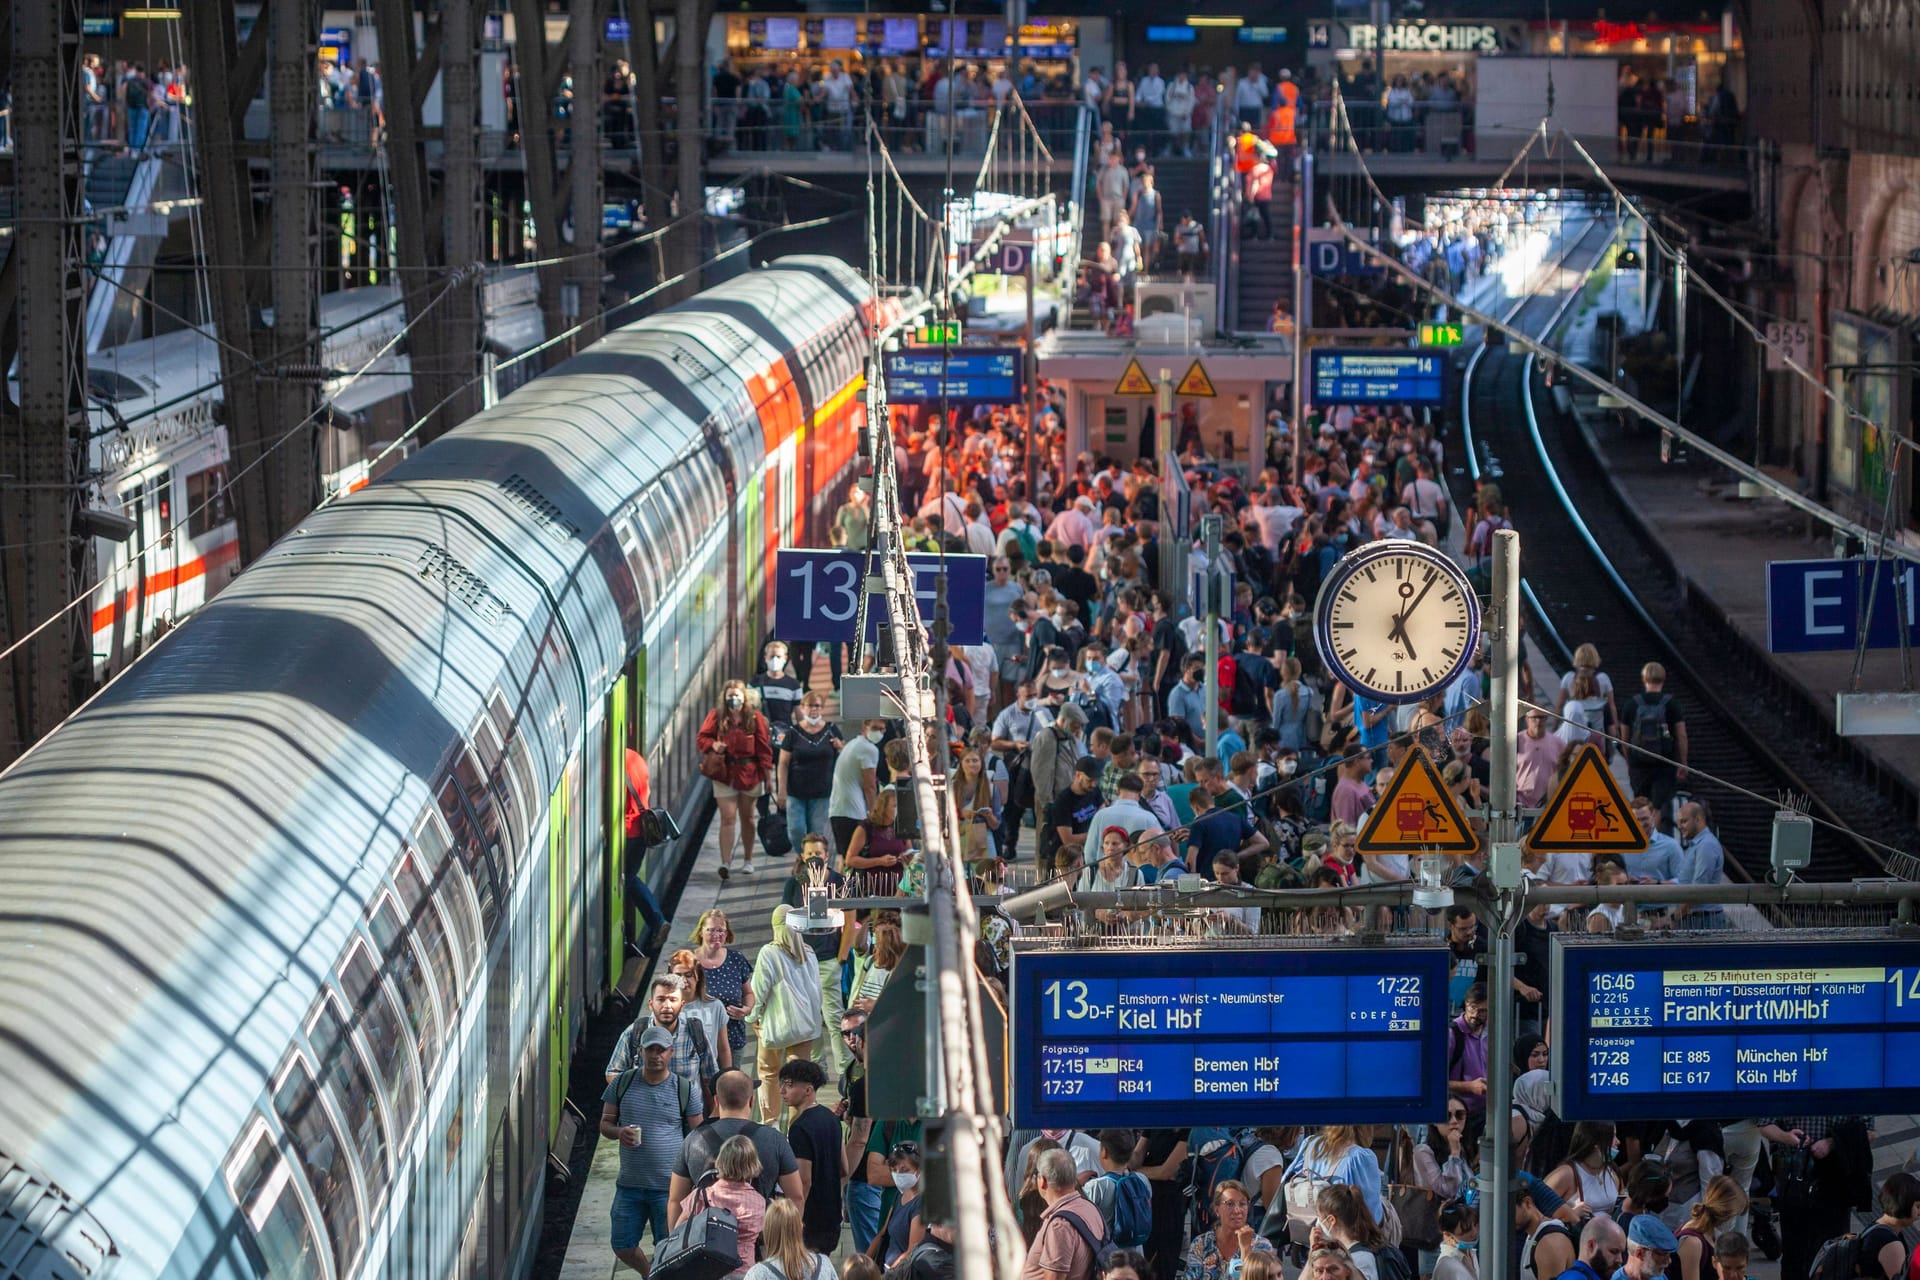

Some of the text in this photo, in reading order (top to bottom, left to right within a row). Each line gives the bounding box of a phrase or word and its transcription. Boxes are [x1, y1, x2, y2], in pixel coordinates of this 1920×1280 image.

[1003, 245, 1024, 272] D
[1319, 243, 1339, 271] D
[1417, 357, 1433, 373] 14
[790, 560, 858, 622] 13
[1804, 570, 1845, 635] E
[1377, 977, 1420, 994] 17:22
[1592, 973, 1635, 991] 16:46
[1681, 973, 1700, 983] ca.
[1703, 972, 1717, 982] 25
[1721, 971, 1772, 982] Minuten
[1119, 994, 1169, 1005] Elmshorn
[1179, 993, 1209, 1005] Wrist
[1220, 992, 1285, 1004] Neumünster
[1591, 992, 1629, 1004] IC 2215
[1664, 986, 1703, 998] Bremen
[1704, 986, 1723, 997] Hbf
[1733, 985, 1791, 997] Düsseldorf
[1793, 984, 1811, 995] Hbf
[1822, 984, 1846, 995] Köln
[1848, 983, 1866, 994] Hbf
[1044, 980, 1115, 1020] 13 D-F
[1394, 995, 1420, 1007] RE70
[1119, 1008, 1203, 1030] Kiel Hbf
[1663, 999, 1830, 1022] Frankfurt(M)Hbf
[1042, 1045, 1090, 1056] Folgezüge
[1589, 1038, 1635, 1048] Folgezüge
[1043, 1058, 1084, 1074] 17:15
[1118, 1059, 1144, 1072] RE4
[1194, 1057, 1249, 1072] Bremen
[1254, 1056, 1280, 1071] Hbf
[1590, 1047, 1828, 1066] 17:28 ICE 885 München Hbf
[1043, 1077, 1280, 1095] 17:37 RB41 Bremen Hbf
[1590, 1068, 1798, 1086] 17:46 ICE 617 Köln Hbf
